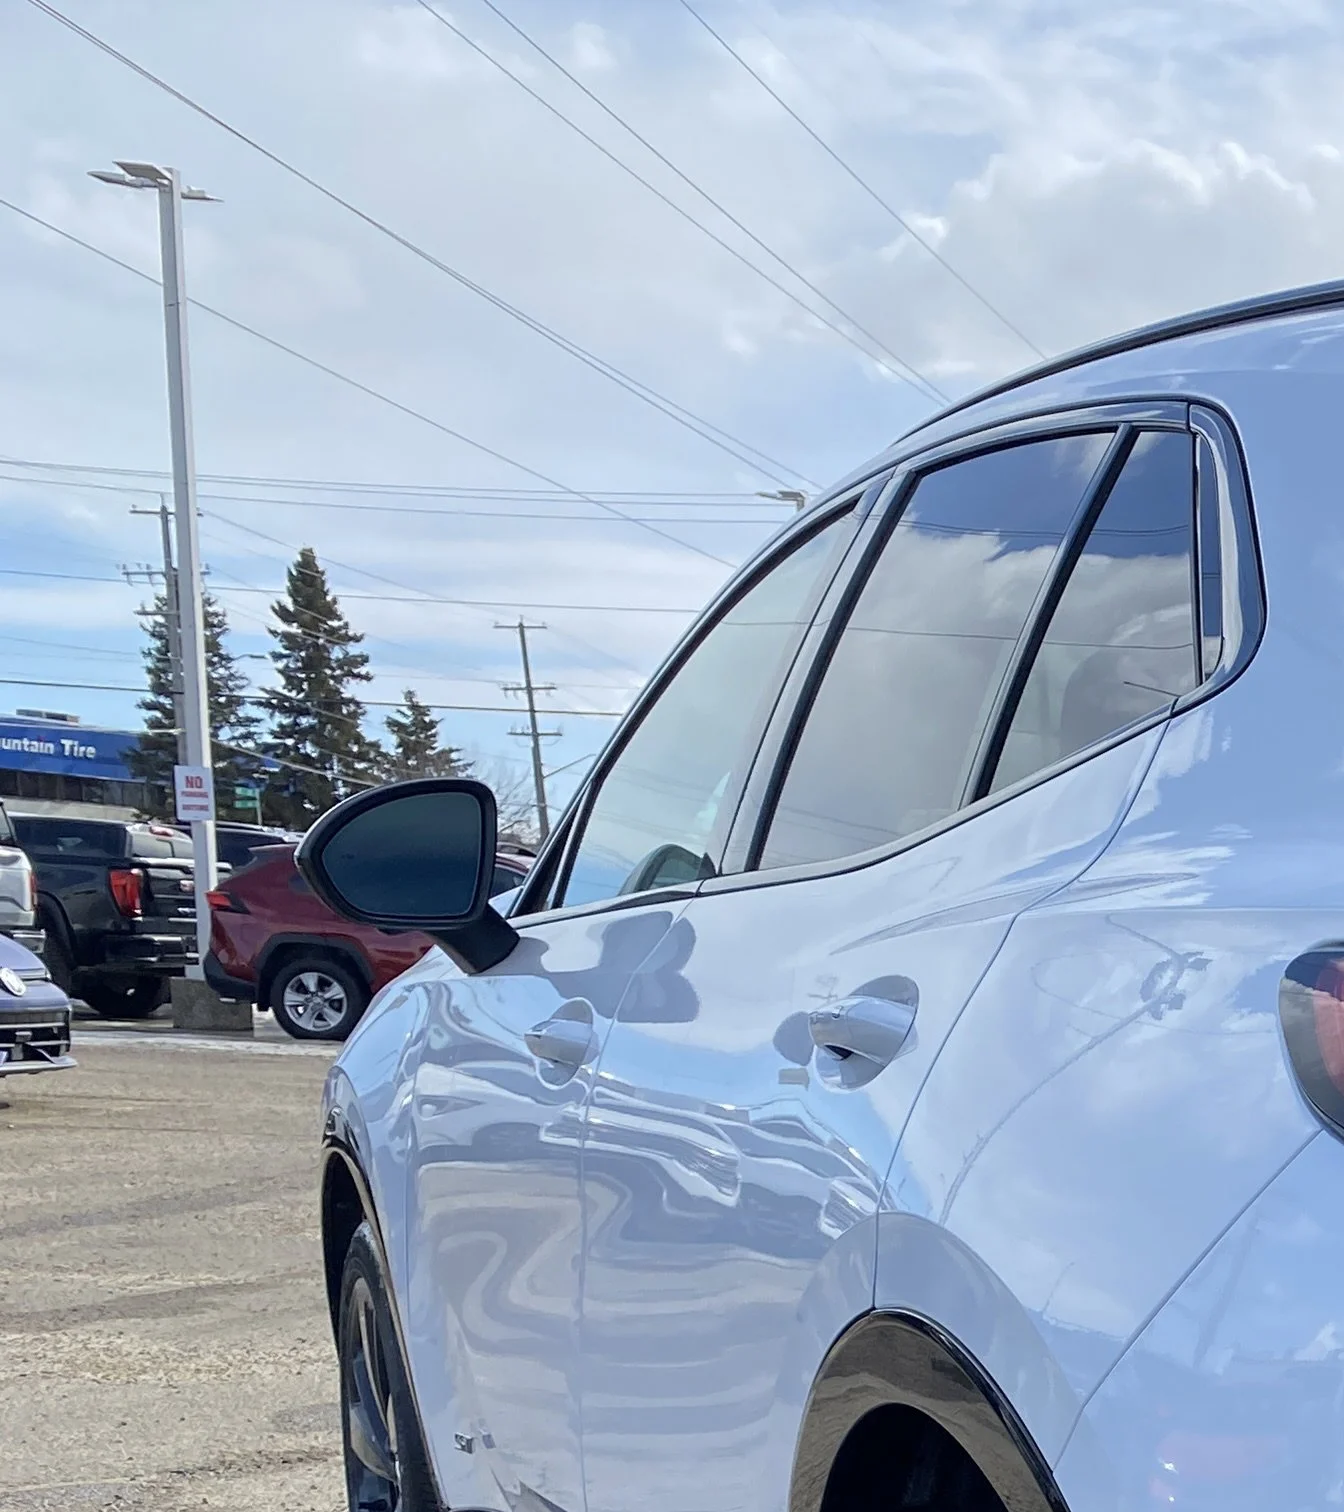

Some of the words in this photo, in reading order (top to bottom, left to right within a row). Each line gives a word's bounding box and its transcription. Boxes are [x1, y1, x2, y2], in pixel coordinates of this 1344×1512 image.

[0, 737, 55, 755] untain
[60, 738, 97, 759] Tire
[184, 775, 204, 789] NO
